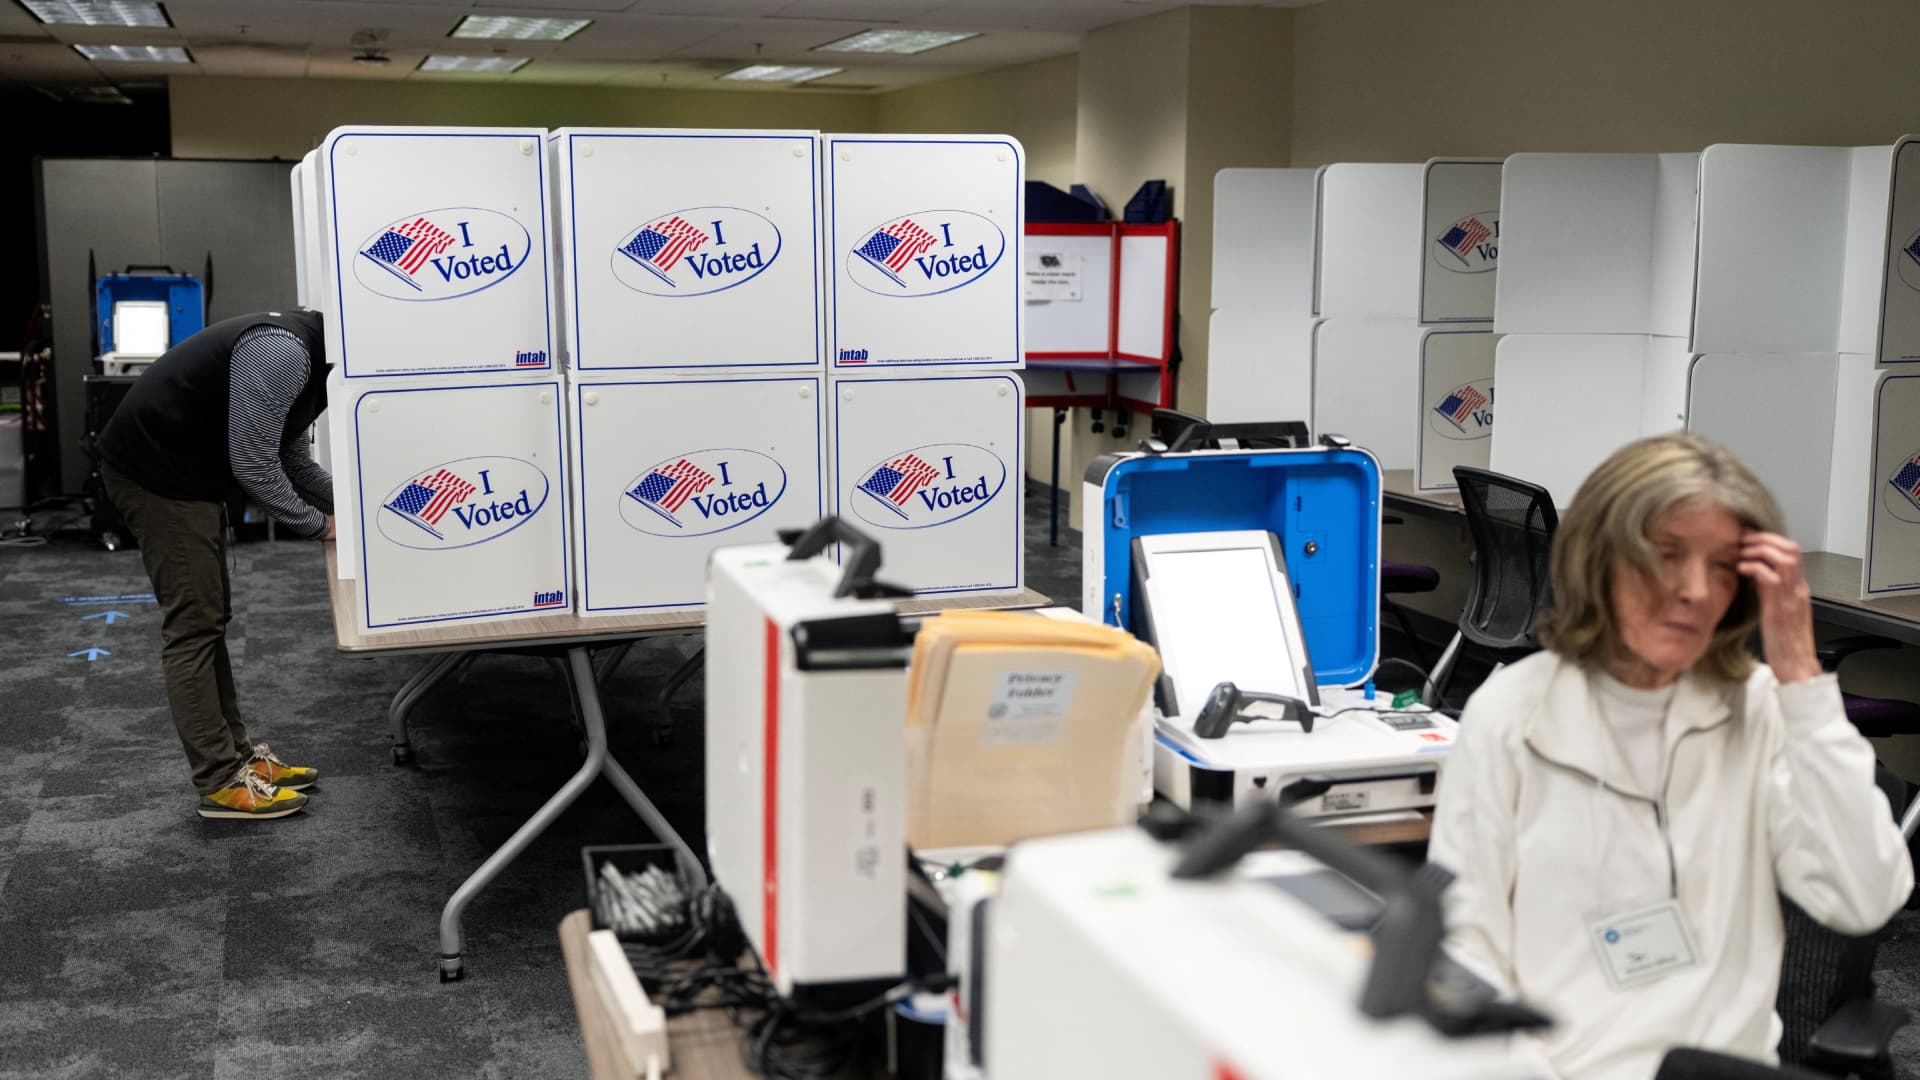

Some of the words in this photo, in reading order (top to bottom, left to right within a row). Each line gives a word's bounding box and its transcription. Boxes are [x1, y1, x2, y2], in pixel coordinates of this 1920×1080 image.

[457, 222, 474, 248] I
[710, 220, 726, 246] I
[939, 222, 955, 248] I
[430, 244, 514, 282] Voted
[684, 243, 764, 279] Voted
[914, 245, 989, 281] Voted
[516, 350, 546, 364] intab
[839, 348, 869, 362] intab
[717, 461, 733, 487] I
[942, 455, 957, 481] I
[478, 469, 494, 496] I
[917, 475, 990, 512] Voted
[452, 489, 533, 530] Voted
[693, 482, 770, 519] Voted
[534, 591, 563, 605] intab
